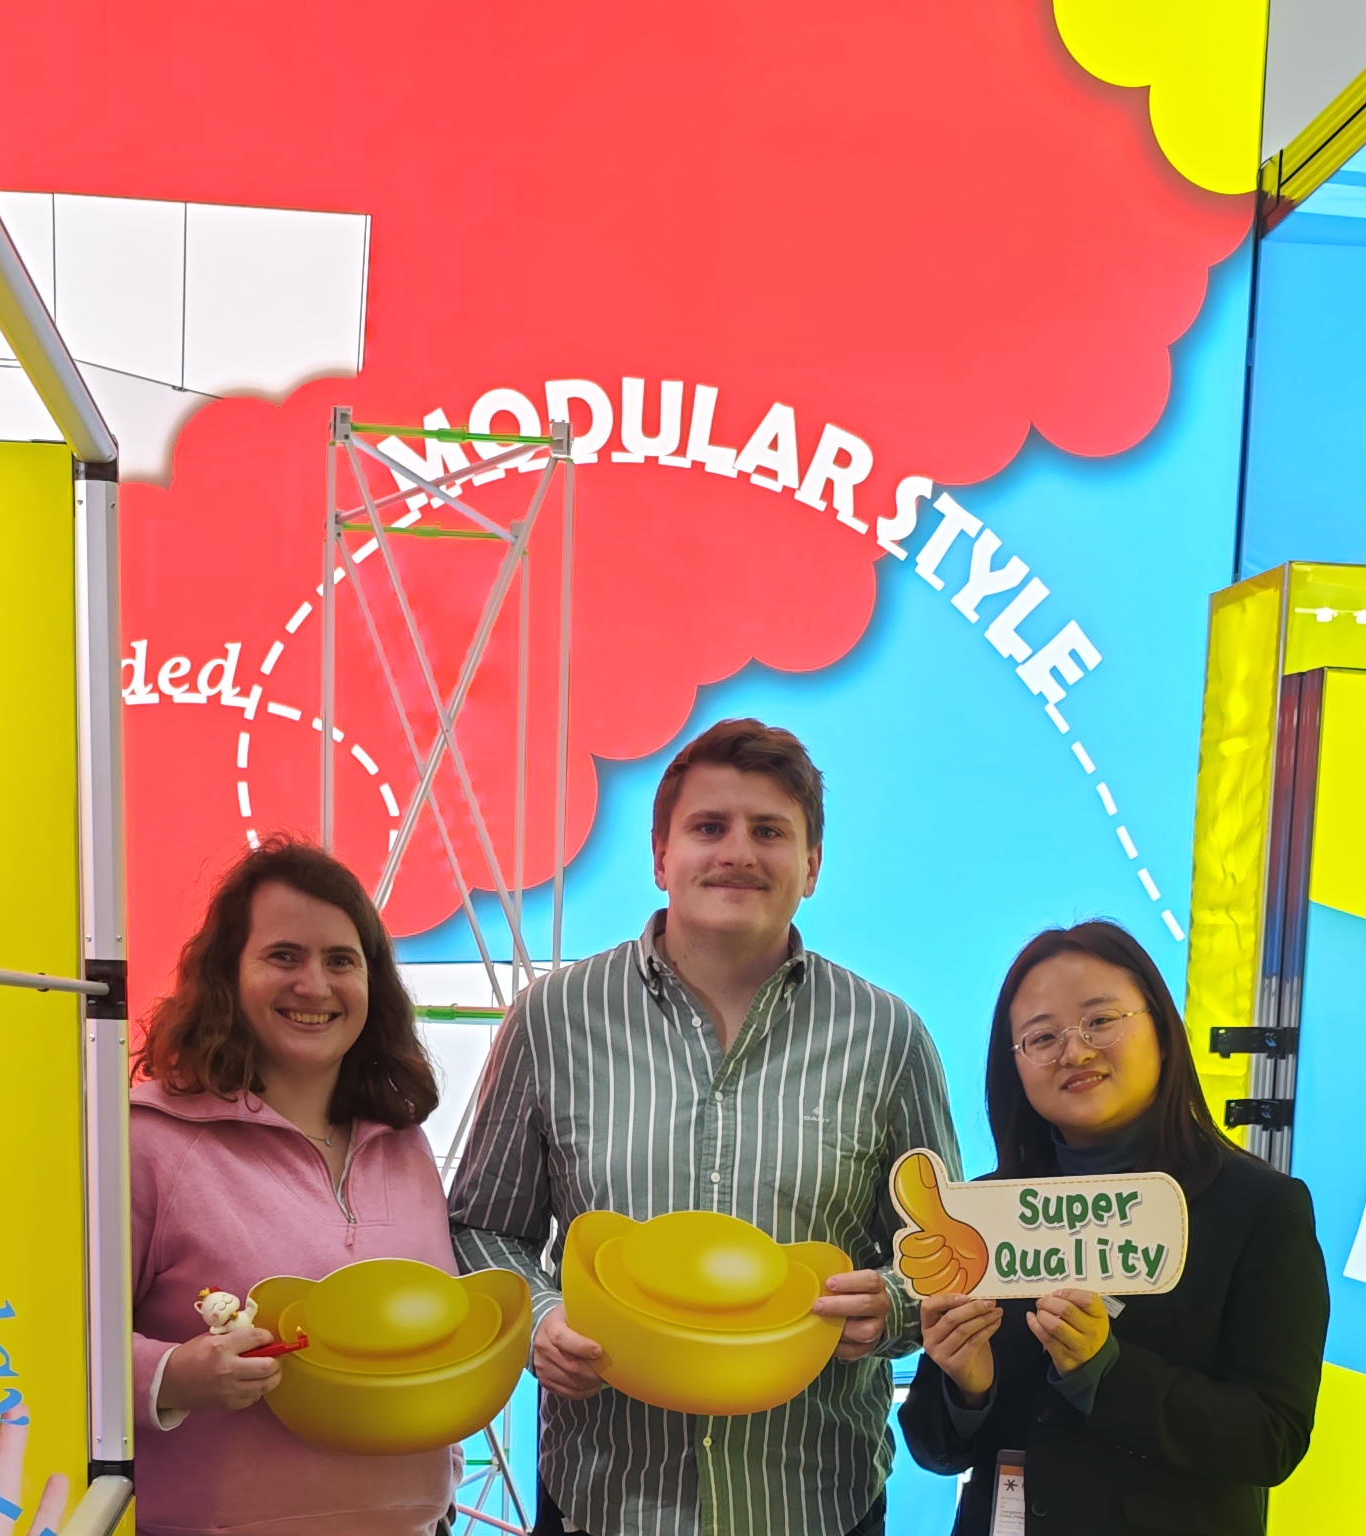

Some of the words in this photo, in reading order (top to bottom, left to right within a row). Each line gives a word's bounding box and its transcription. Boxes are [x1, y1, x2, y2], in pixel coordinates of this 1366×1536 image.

[374, 376, 875, 535] MODULAR
[876, 476, 1102, 702] STYLE
[1017, 1187, 1143, 1233] Super
[994, 1236, 1169, 1284] Quality
